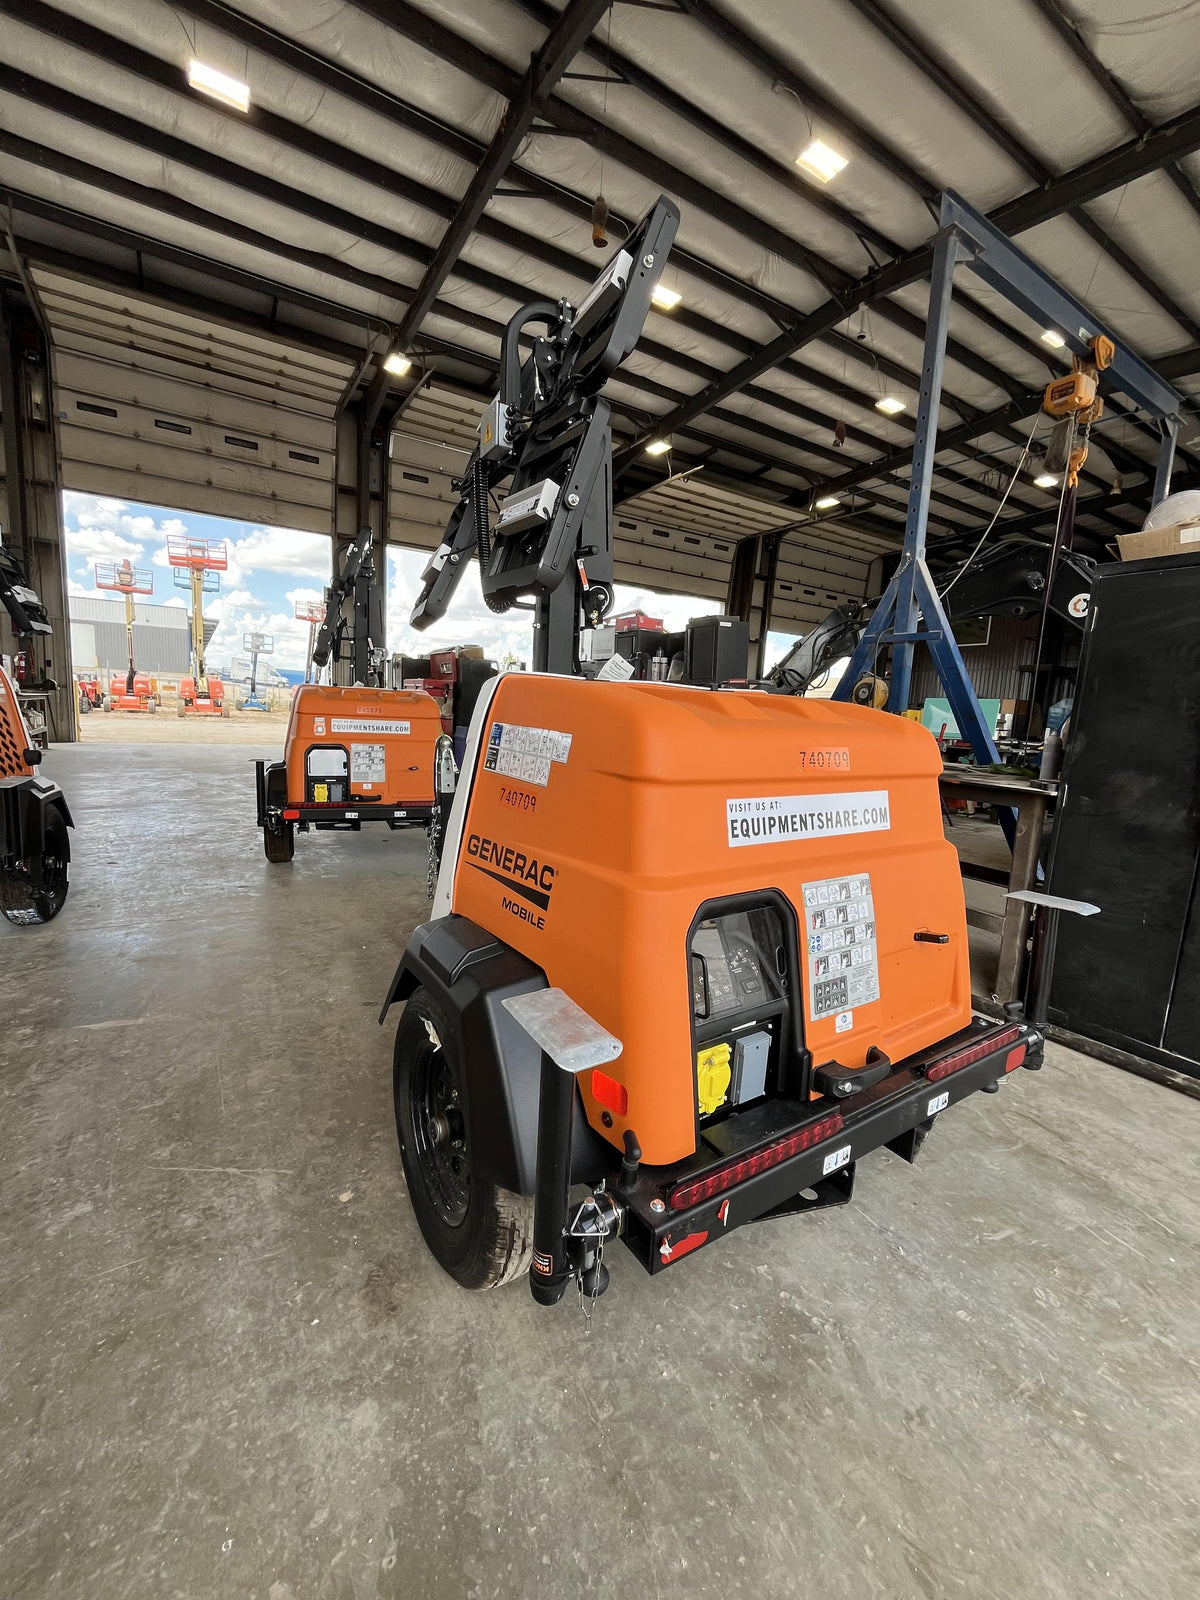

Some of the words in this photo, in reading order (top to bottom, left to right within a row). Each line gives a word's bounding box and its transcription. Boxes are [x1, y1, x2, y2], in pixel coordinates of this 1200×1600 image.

[332, 723, 409, 732] EQUIPMENTSHARE.COM
[800, 751, 849, 768] 740709
[500, 788, 537, 812] 740709
[729, 802, 752, 813] VISIT
[755, 801, 766, 811] US
[769, 801, 782, 810] AT:
[730, 806, 888, 839] EQUIPMENTSHARE.COM
[467, 834, 555, 892] GENERAC
[501, 896, 546, 931] MOBILE
